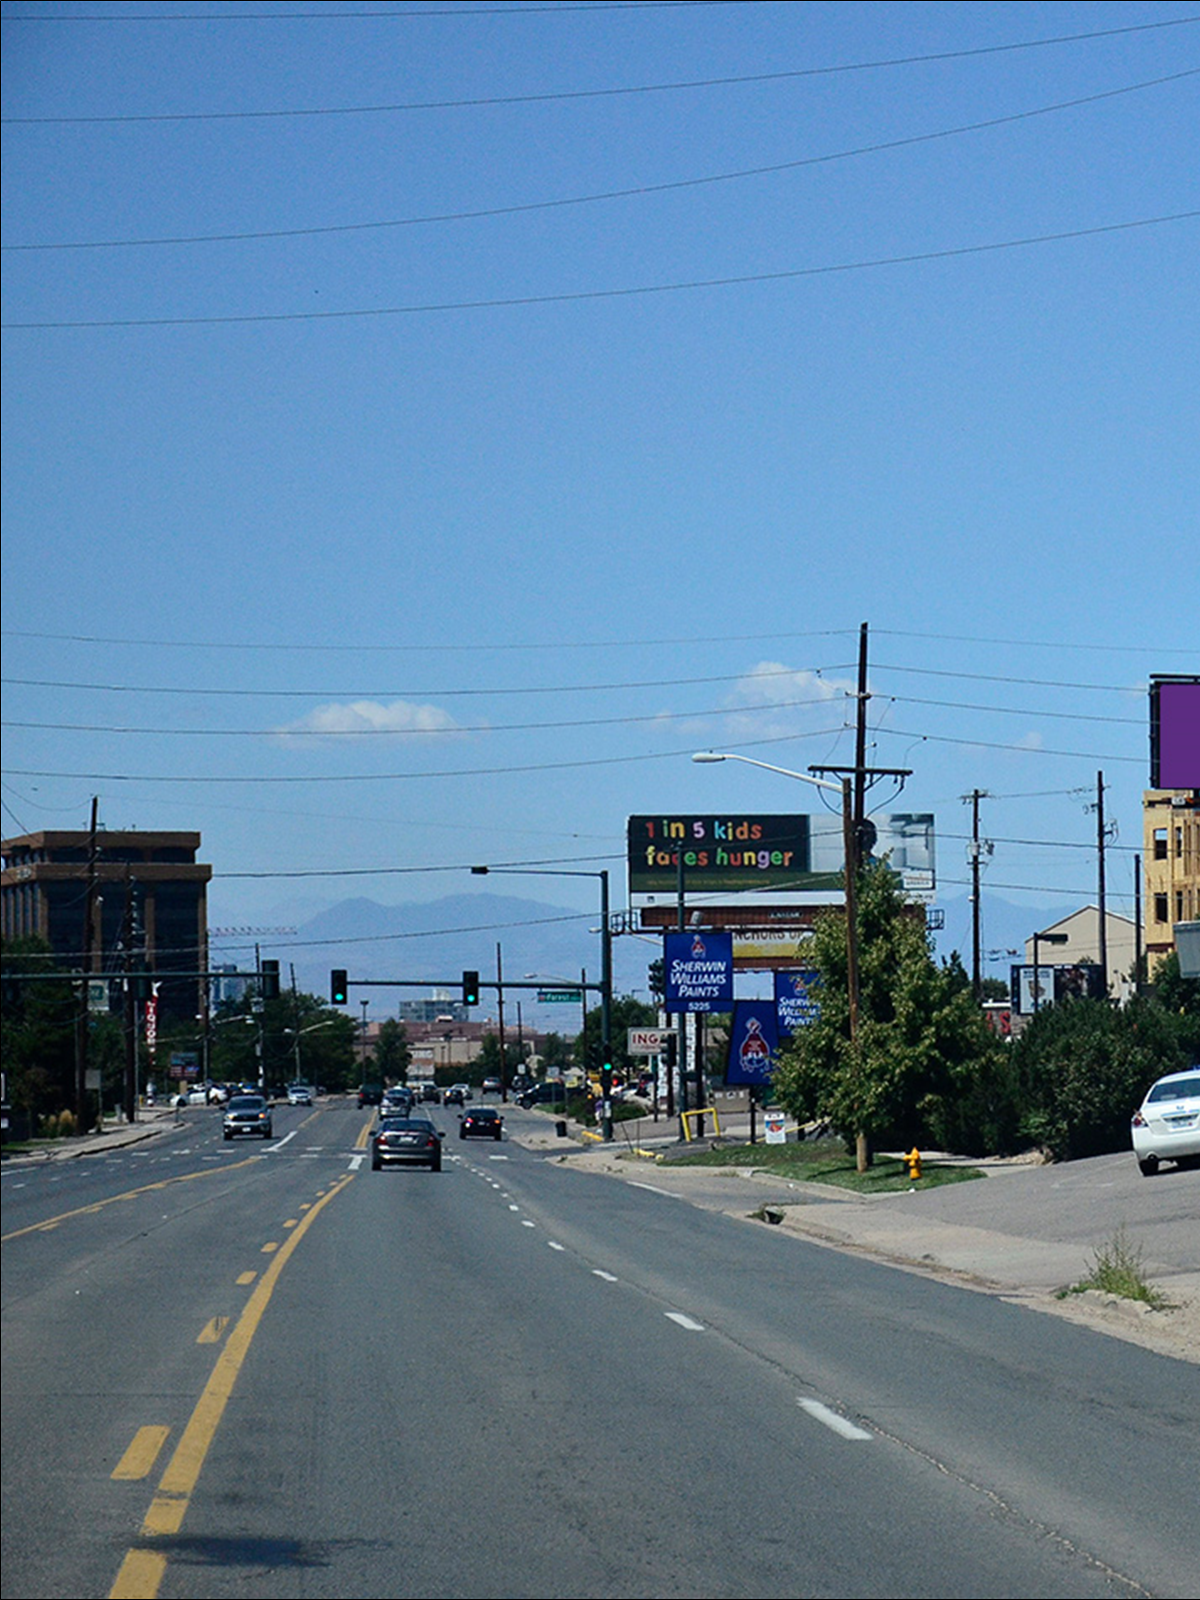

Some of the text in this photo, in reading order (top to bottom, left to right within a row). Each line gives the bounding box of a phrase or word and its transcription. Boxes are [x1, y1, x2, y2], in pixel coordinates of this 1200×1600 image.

[645, 819, 763, 841] 1 in 5 kids
[645, 845, 794, 870] faces hunger
[672, 959, 726, 973] SHERWIN
[670, 972, 727, 985] WILLIAMS
[678, 985, 720, 997] PAINTS
[688, 1002, 710, 1010] 5225
